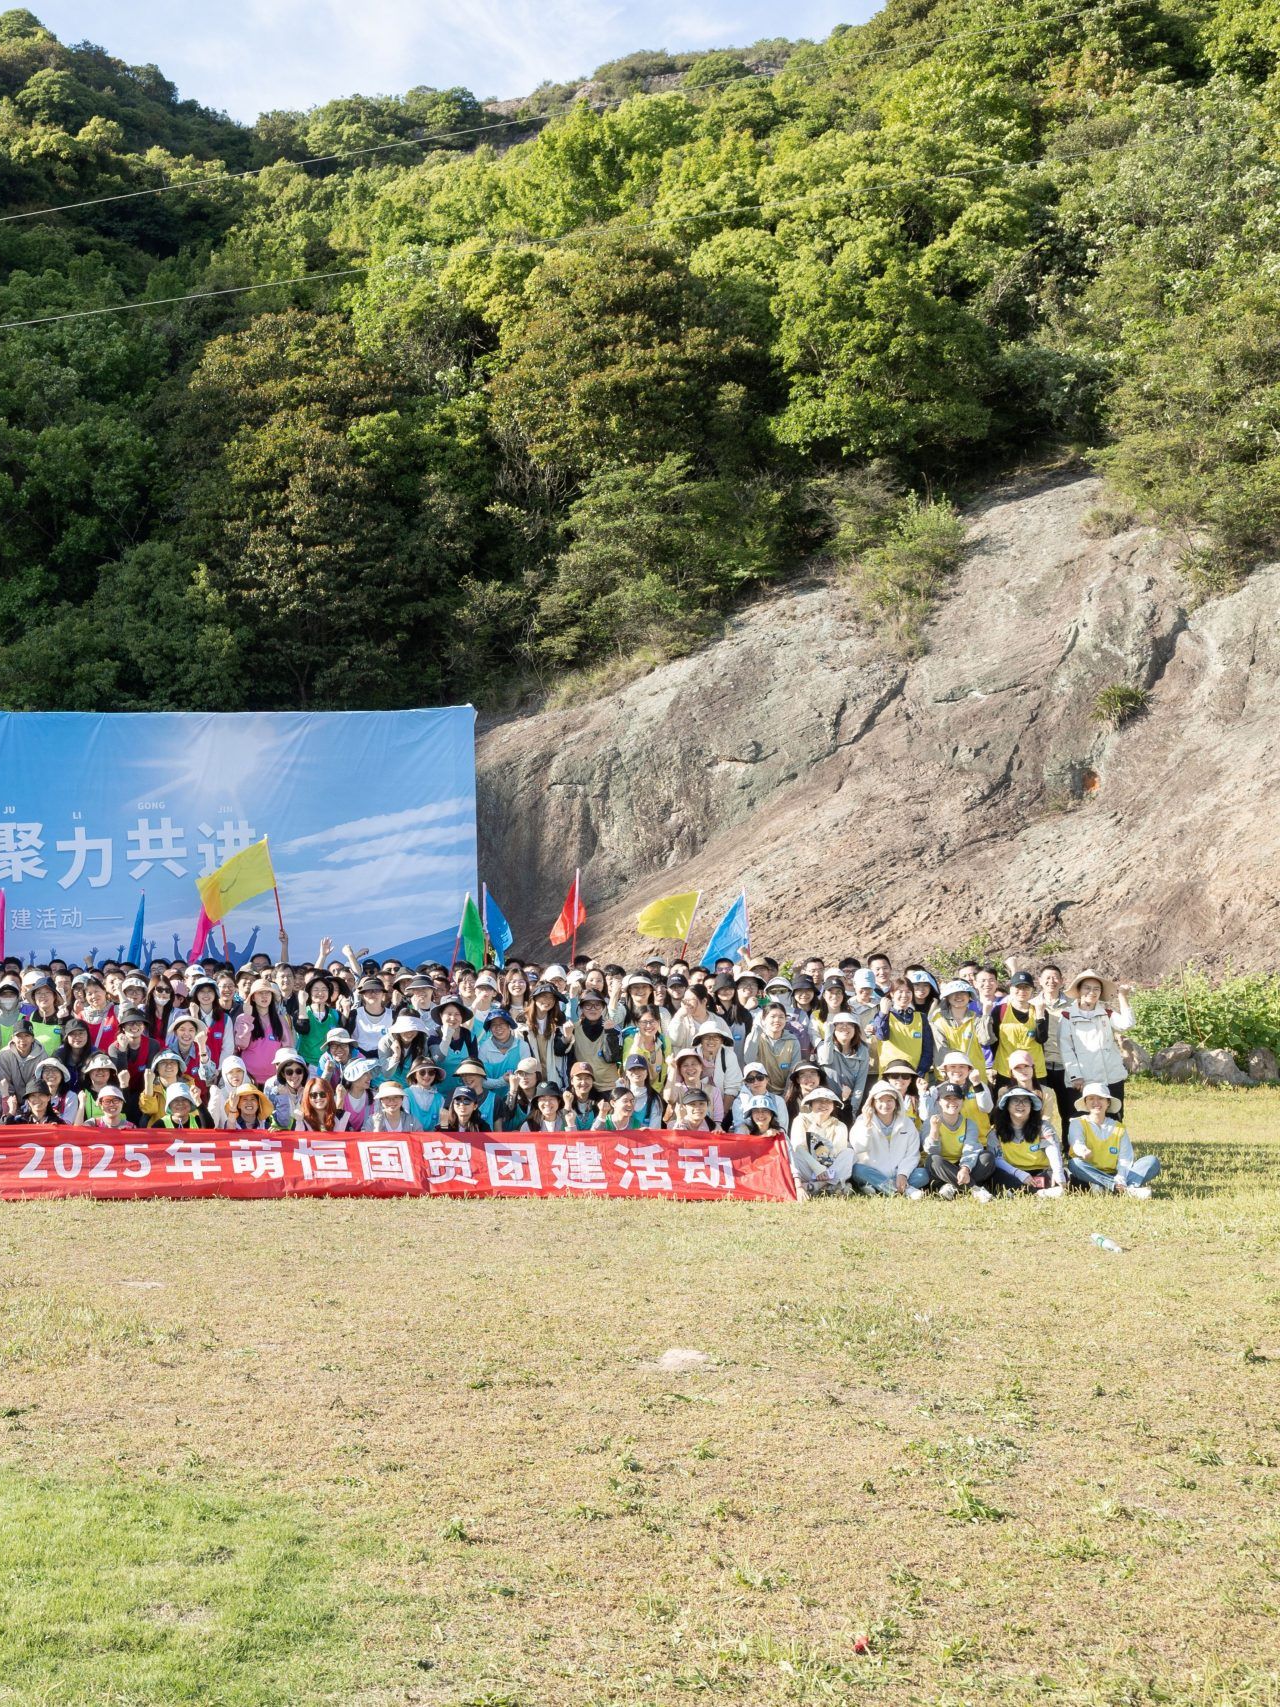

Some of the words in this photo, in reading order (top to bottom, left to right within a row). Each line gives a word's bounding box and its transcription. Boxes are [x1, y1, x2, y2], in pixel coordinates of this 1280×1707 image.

[3, 806, 15, 814] JU
[73, 811, 81, 820] LI
[137, 801, 166, 810] GONG
[217, 806, 233, 814] JIN
